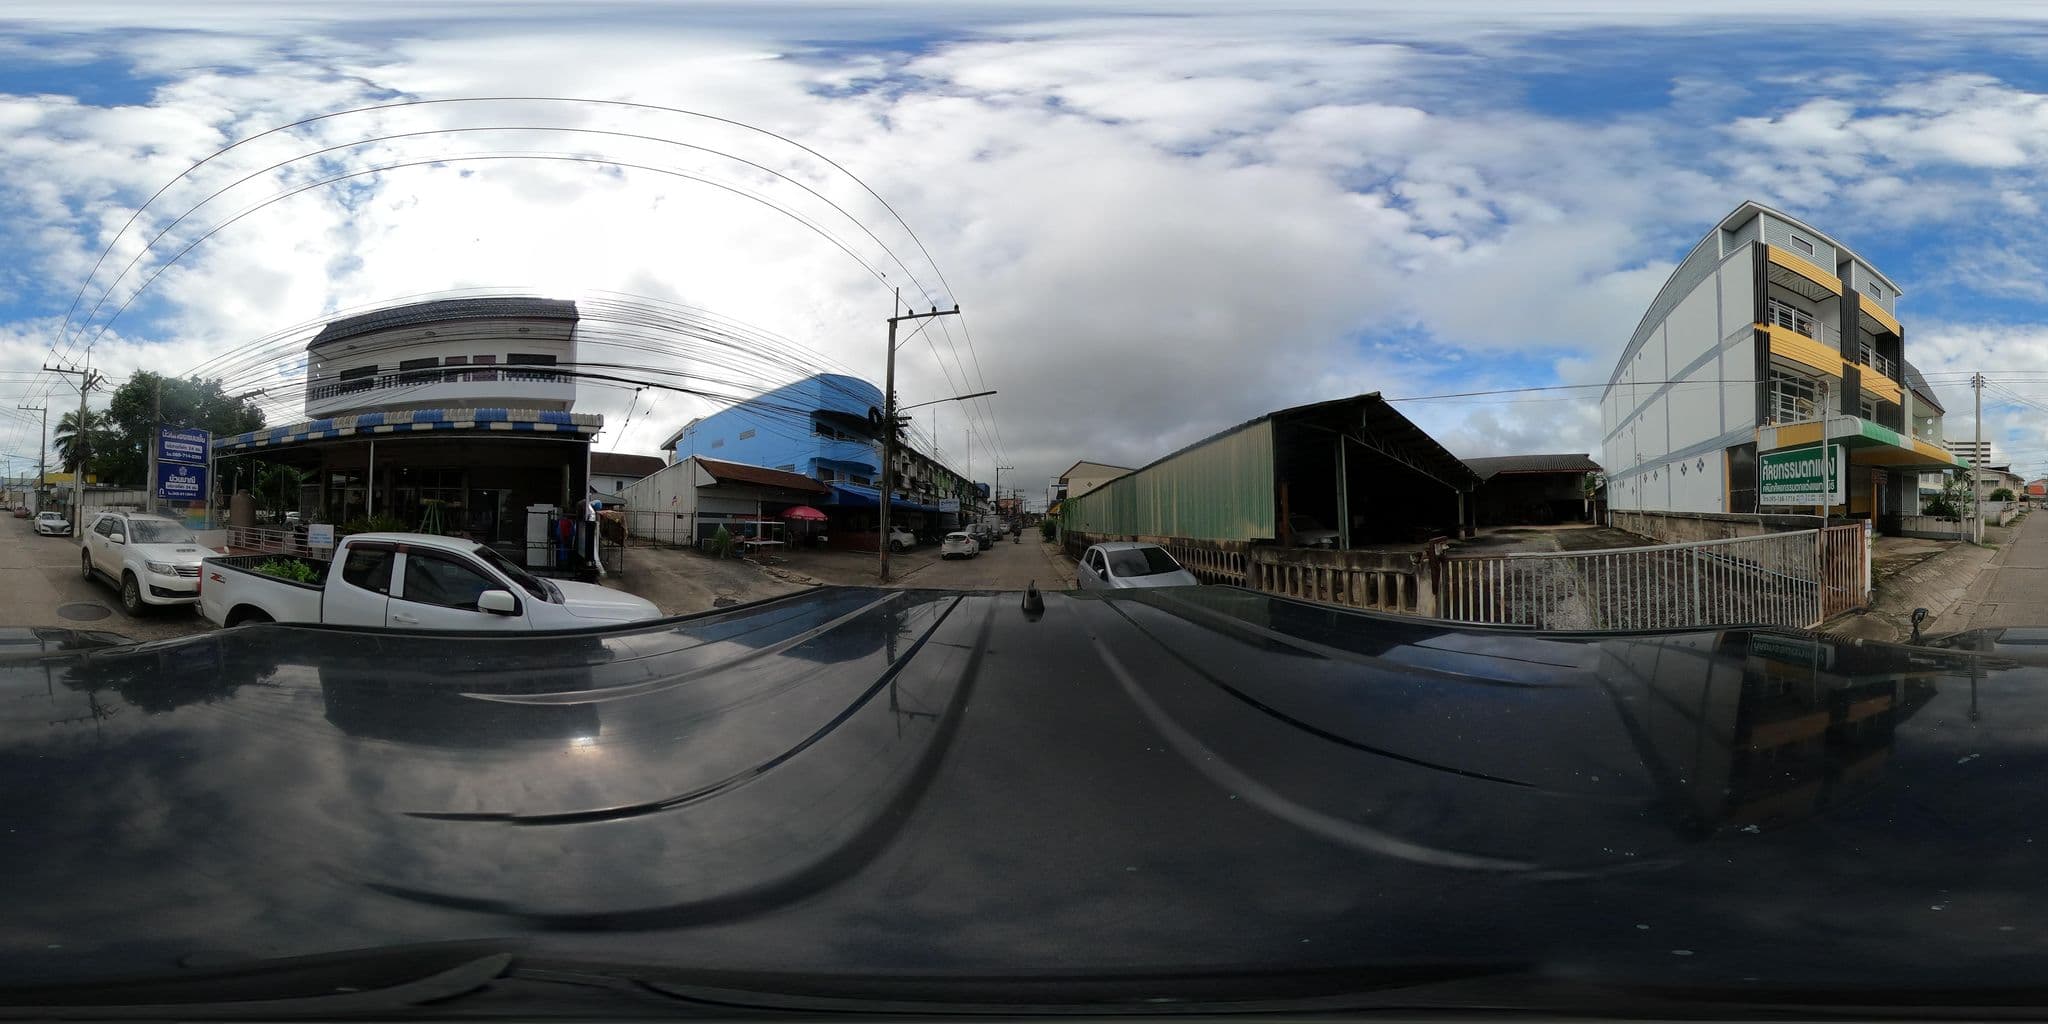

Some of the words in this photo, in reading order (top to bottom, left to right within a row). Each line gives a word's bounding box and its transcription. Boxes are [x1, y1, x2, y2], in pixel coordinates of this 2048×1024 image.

[1763, 457, 1835, 481] ศัลยกรรมตกแง
